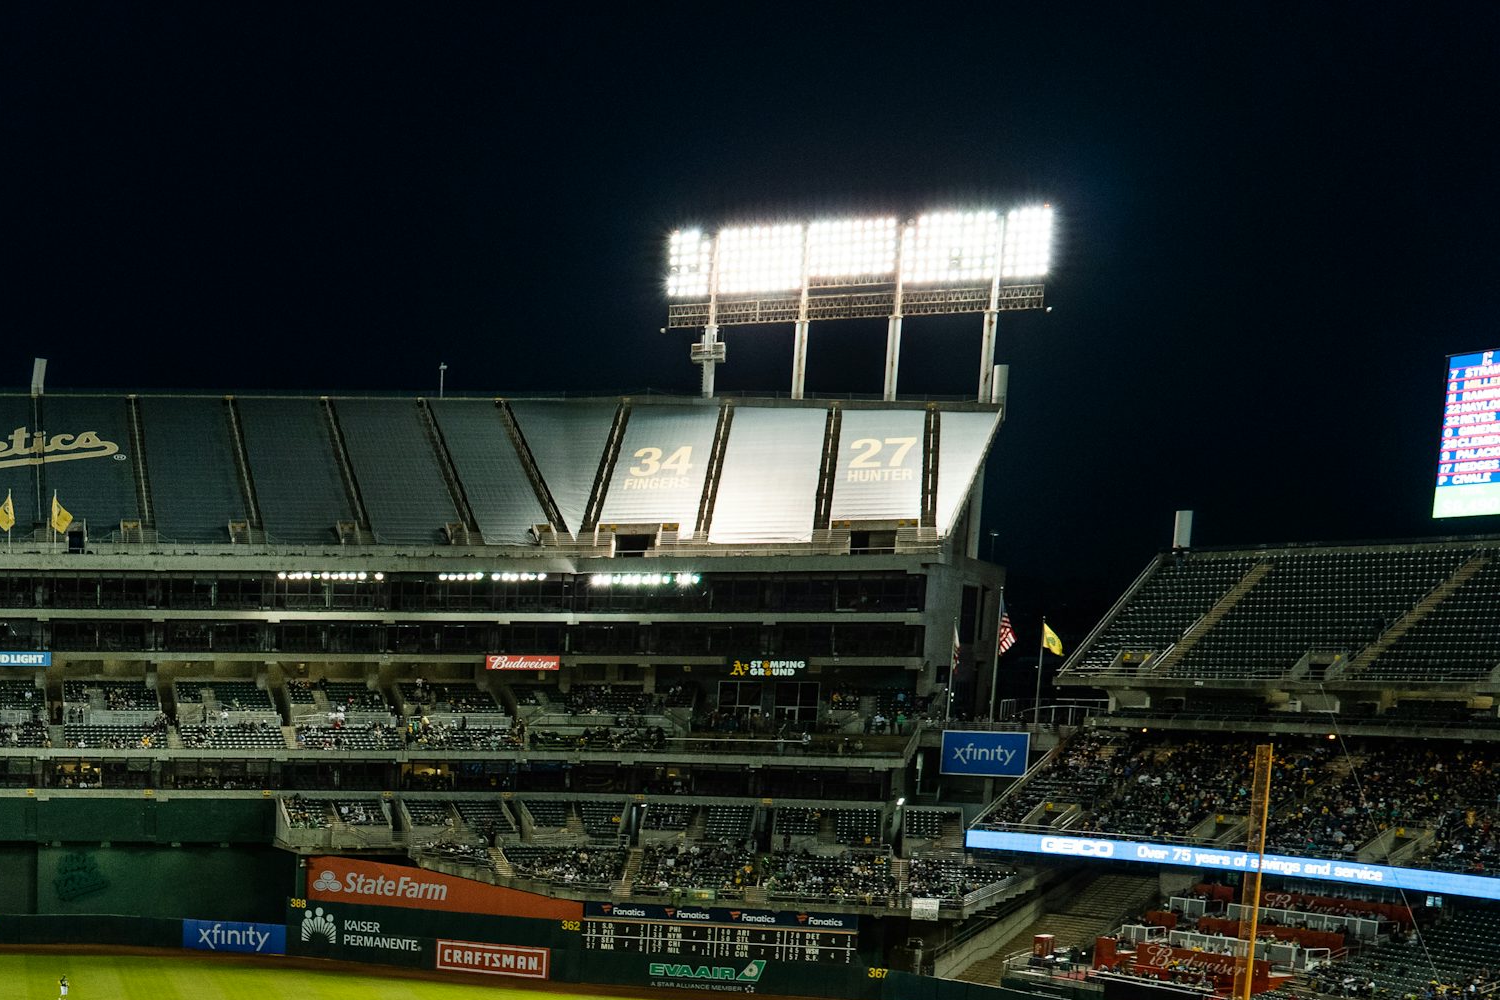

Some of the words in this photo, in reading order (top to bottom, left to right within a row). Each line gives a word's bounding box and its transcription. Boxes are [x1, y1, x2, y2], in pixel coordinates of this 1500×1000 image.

[1451, 370, 1459, 379] 7
[848, 436, 918, 468] 27
[630, 446, 693, 478] 34
[847, 468, 913, 482] HUNTER
[624, 476, 690, 490] FINGERS
[10, 654, 44, 664] LIGHT
[489, 656, 558, 670] Budweiser
[730, 660, 749, 676] A's
[952, 742, 1016, 765] xfinity
[1040, 836, 1114, 858] GEICO
[1136, 844, 1169, 861] Over
[1172, 846, 1192, 862] 75
[1194, 850, 1231, 870] years
[1234, 852, 1248, 868] of
[1250, 855, 1300, 878] savings
[1304, 860, 1330, 878] and
[1334, 864, 1383, 882] service
[290, 898, 307, 908] 388
[612, 907, 646, 917] Fanatics
[676, 910, 710, 920] Fanatics
[742, 914, 776, 924] Fanatics
[808, 917, 843, 927] Fanatics
[344, 920, 380, 934] KAISER
[562, 920, 580, 931] 362
[198, 924, 270, 952] xfinity
[343, 934, 418, 952] PERMANENTE
[443, 948, 540, 971] CRAFTSMAN
[868, 967, 888, 979] 367
